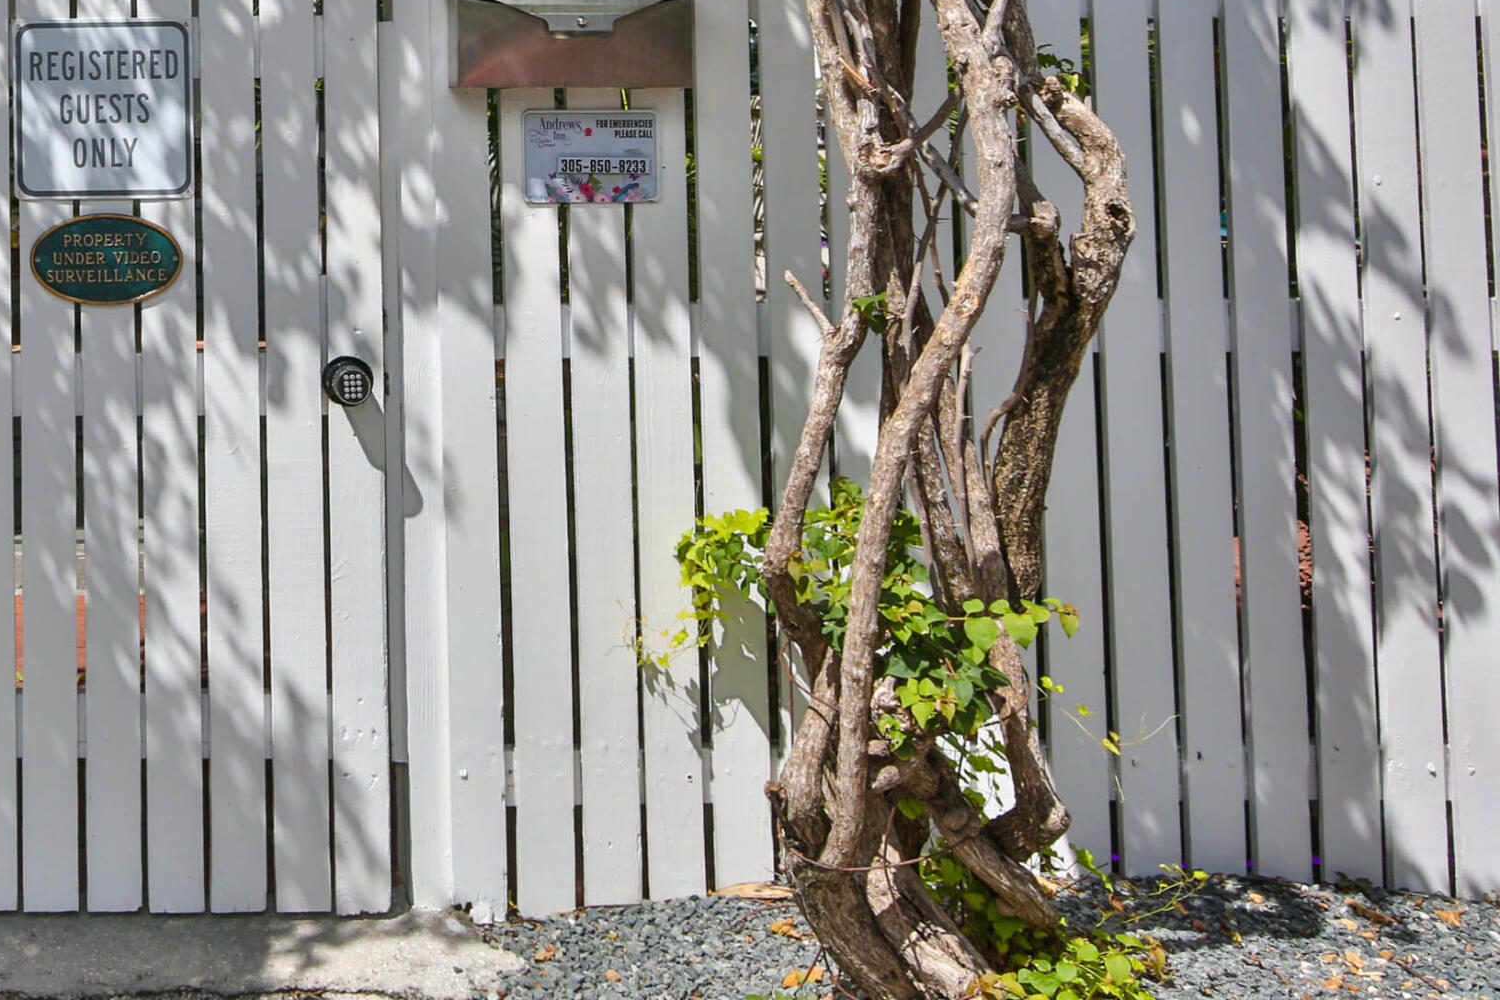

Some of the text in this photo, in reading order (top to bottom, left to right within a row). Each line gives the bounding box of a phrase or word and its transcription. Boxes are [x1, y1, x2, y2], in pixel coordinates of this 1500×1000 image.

[29, 49, 179, 81] REGISTERED
[59, 93, 150, 125] GUESTS
[595, 119, 653, 128] FOR EMERGENCIES
[614, 129, 653, 138] PLEASE CALL
[73, 137, 139, 168] ONLY
[561, 158, 646, 173] 305-850-8233
[63, 233, 147, 247] PROPERTY
[53, 250, 161, 265] UNDER VIDEO
[46, 269, 167, 283] SURVEILLANCE
